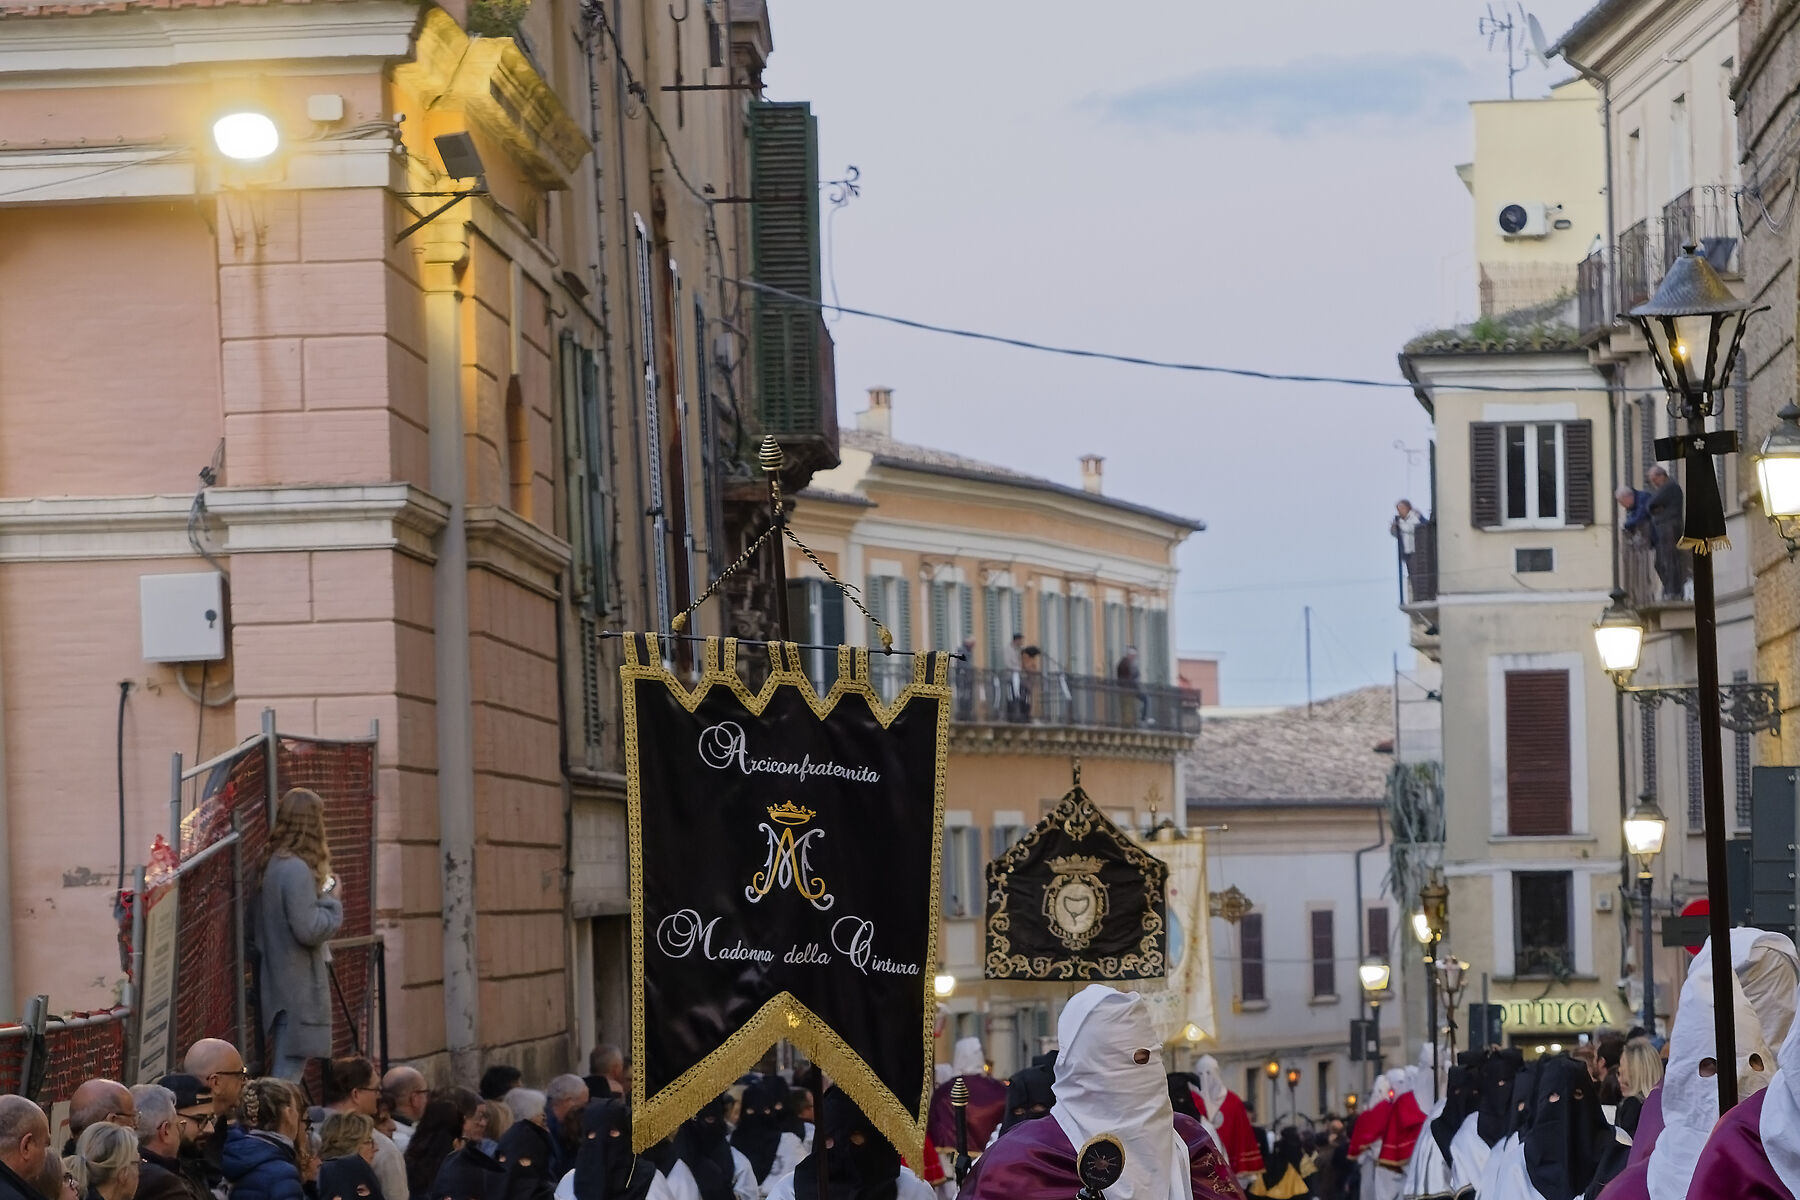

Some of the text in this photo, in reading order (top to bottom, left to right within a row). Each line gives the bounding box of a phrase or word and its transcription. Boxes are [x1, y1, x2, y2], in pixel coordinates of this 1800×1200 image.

[698, 721, 881, 783] Arciconfraternita
[656, 908, 920, 976] Madonna della Cintura
[1500, 1001, 1611, 1027] TTICA
